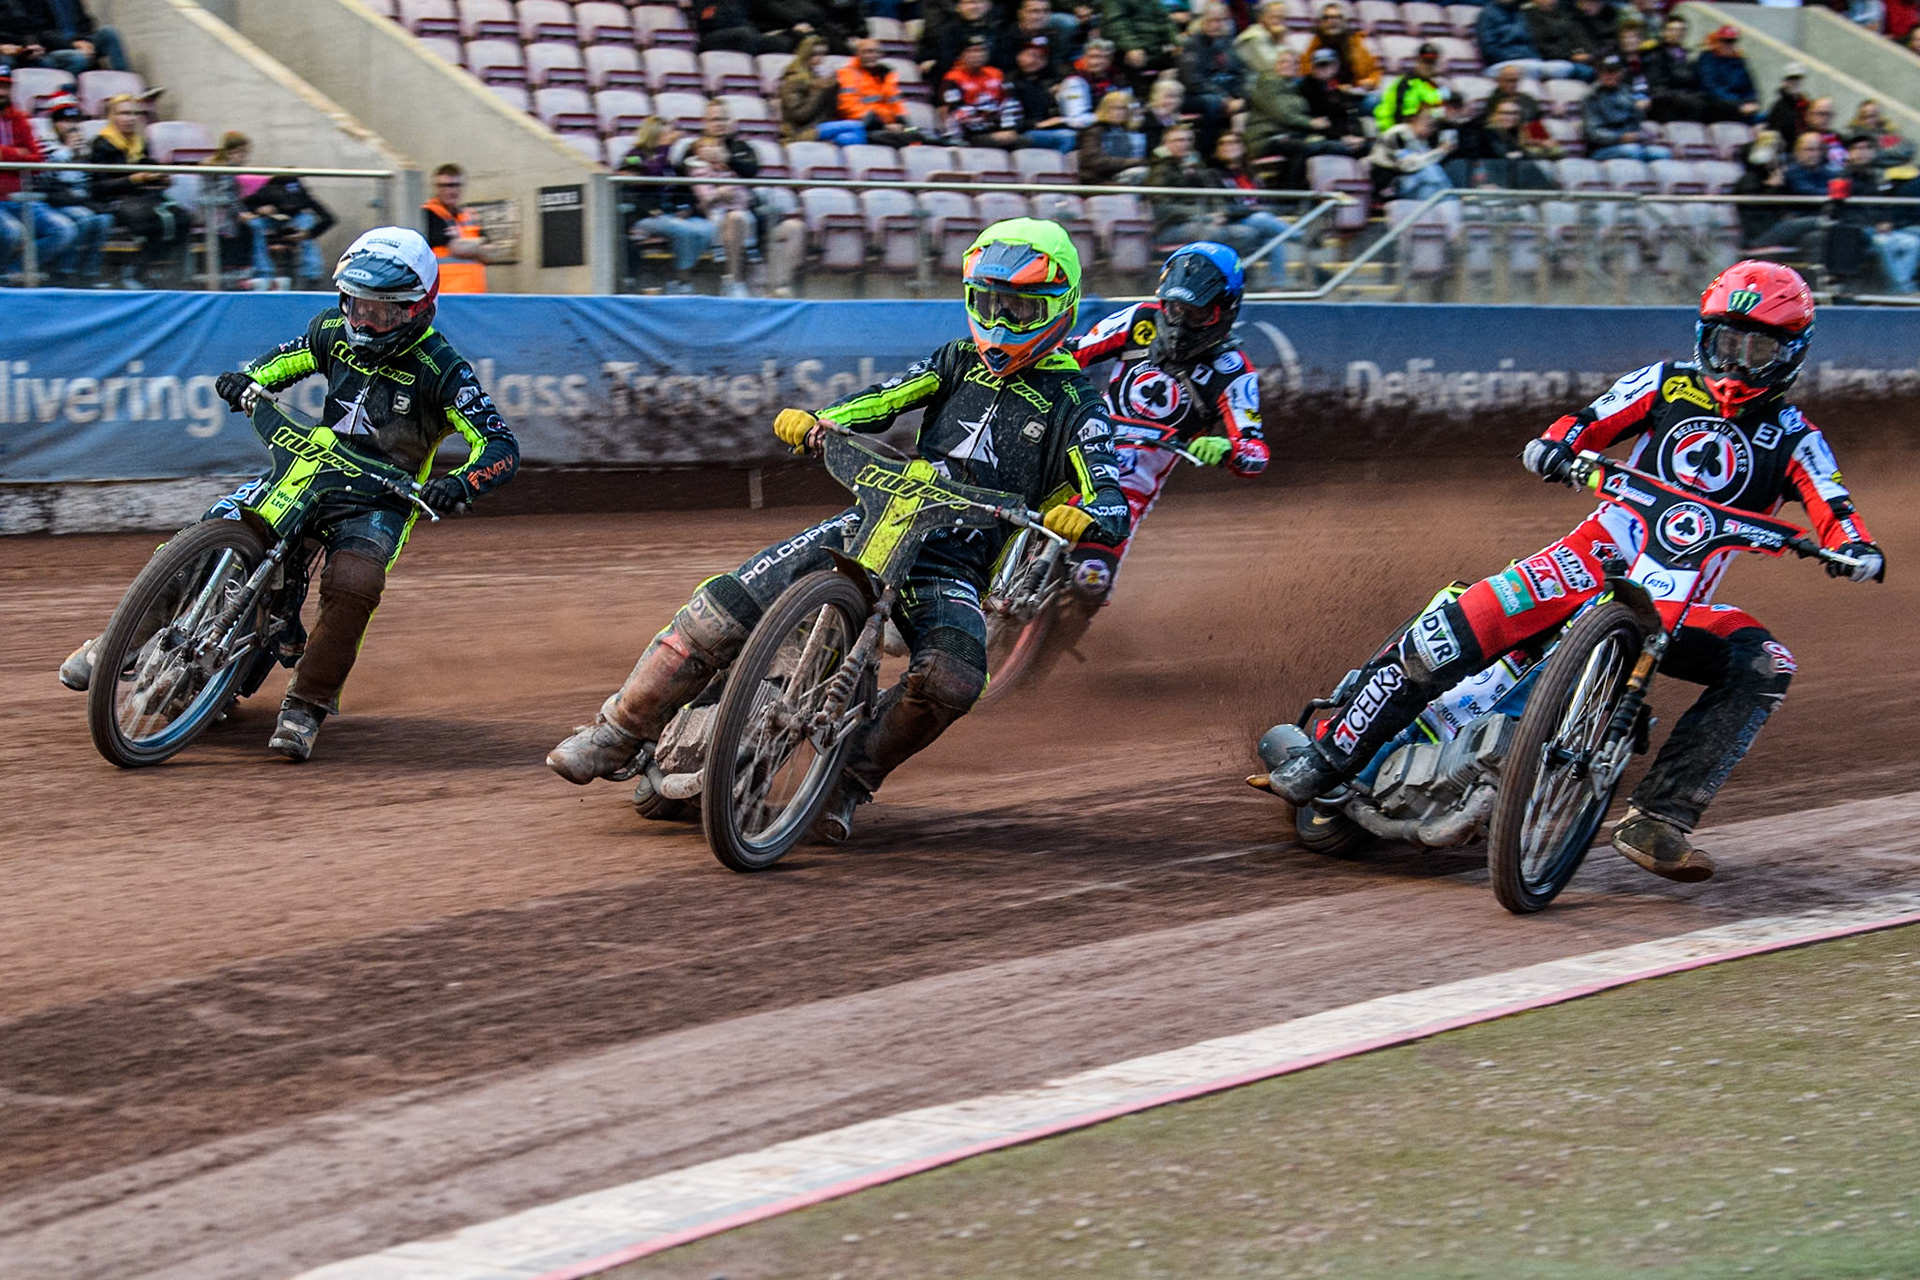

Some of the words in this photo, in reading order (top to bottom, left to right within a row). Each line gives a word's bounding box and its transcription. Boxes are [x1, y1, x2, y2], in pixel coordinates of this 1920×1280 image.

[475, 357, 592, 418] lass
[394, 392, 413, 414] 3
[1022, 420, 1046, 440] 6
[1672, 422, 1709, 440] BELLE
[478, 455, 514, 481] SIMPLY
[270, 498, 286, 509] Ltd
[740, 512, 861, 585] POLCOPPER
[1422, 615, 1454, 662] DVR
[1349, 666, 1402, 731] CELKA
